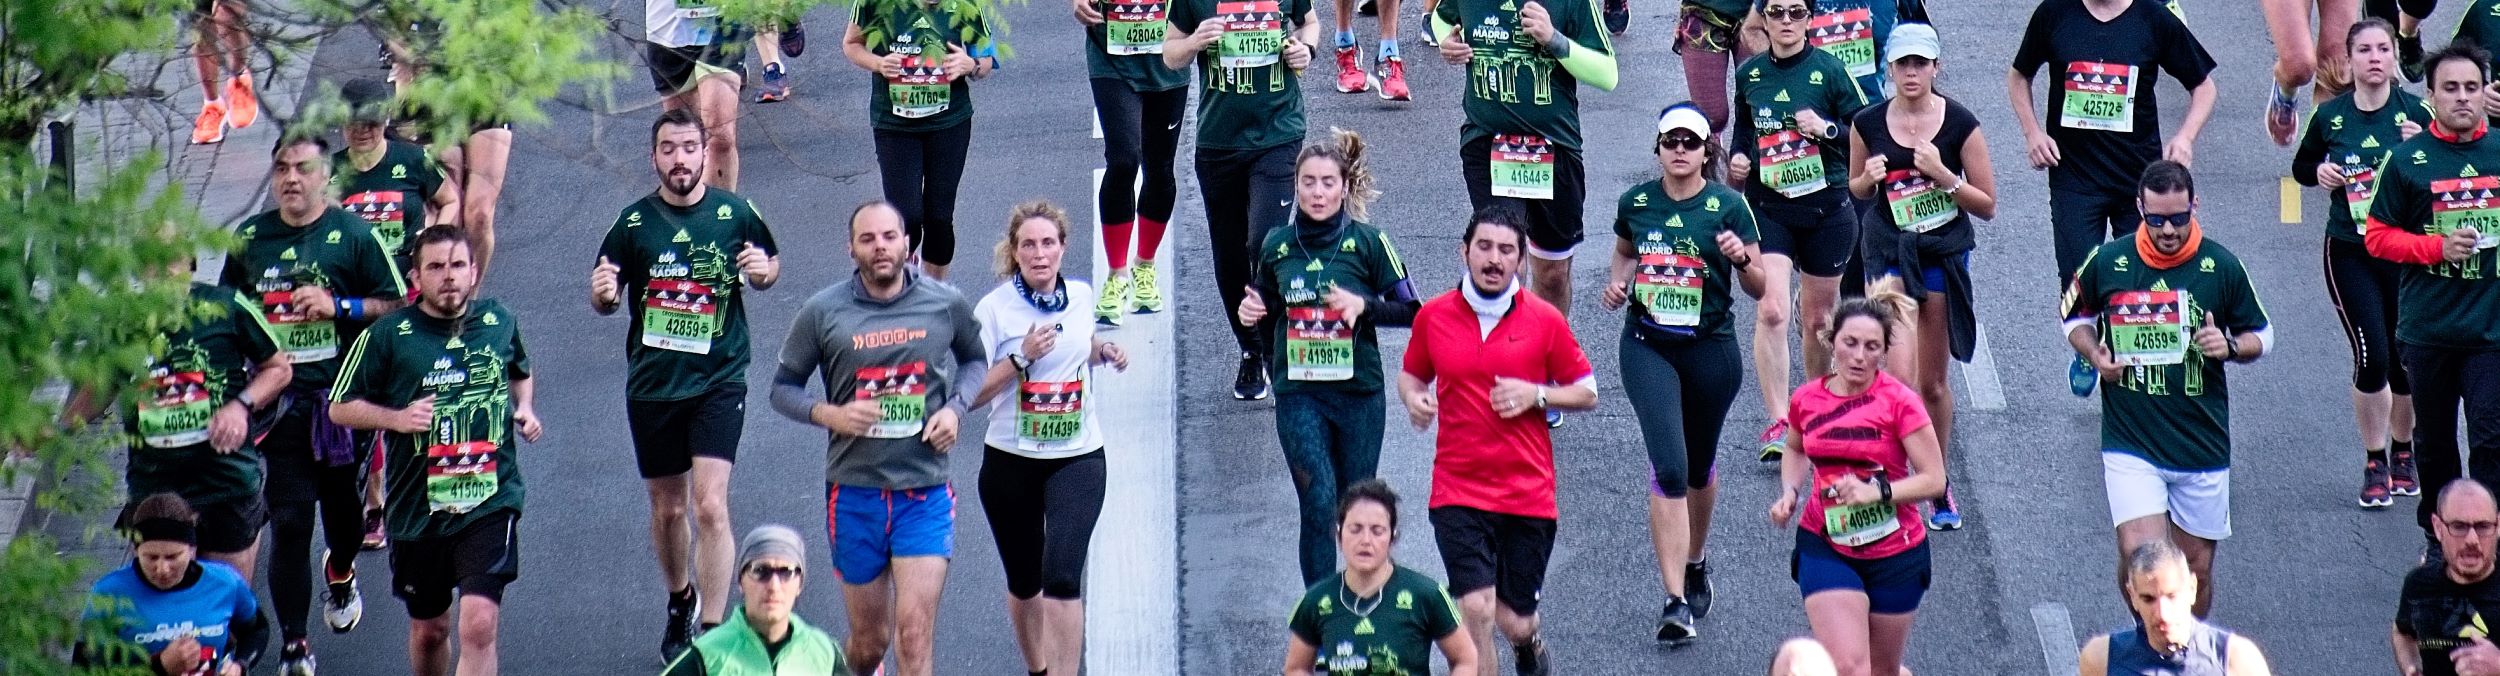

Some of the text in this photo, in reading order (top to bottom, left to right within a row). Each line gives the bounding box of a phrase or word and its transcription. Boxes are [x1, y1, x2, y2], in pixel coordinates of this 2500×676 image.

[1484, 14, 1500, 28] edp
[897, 32, 912, 45] edp
[1126, 28, 1156, 43] 42804
[1472, 28, 1510, 40] MADRID
[890, 46, 922, 54] MADRID
[1238, 38, 1270, 54] 41756
[1488, 69, 1498, 93] 2017
[2083, 99, 2116, 117] 42572
[1753, 120, 1783, 130] MADRID
[2345, 153, 2361, 166] edp
[1511, 168, 1541, 185] 41644
[1647, 230, 1663, 243] edp
[658, 250, 677, 265] edp
[1638, 245, 1674, 255] MADRID
[649, 266, 689, 278] MADRID
[1284, 291, 1317, 304] MADRID
[665, 318, 700, 338] 42859
[288, 328, 323, 348] 42384
[2133, 331, 2169, 351] 42659
[434, 356, 453, 371] edp
[423, 373, 466, 387] MADRID
[880, 402, 912, 421] 2630
[164, 410, 199, 433] 40821
[440, 420, 451, 445] 2017
[449, 481, 485, 499] 41500
